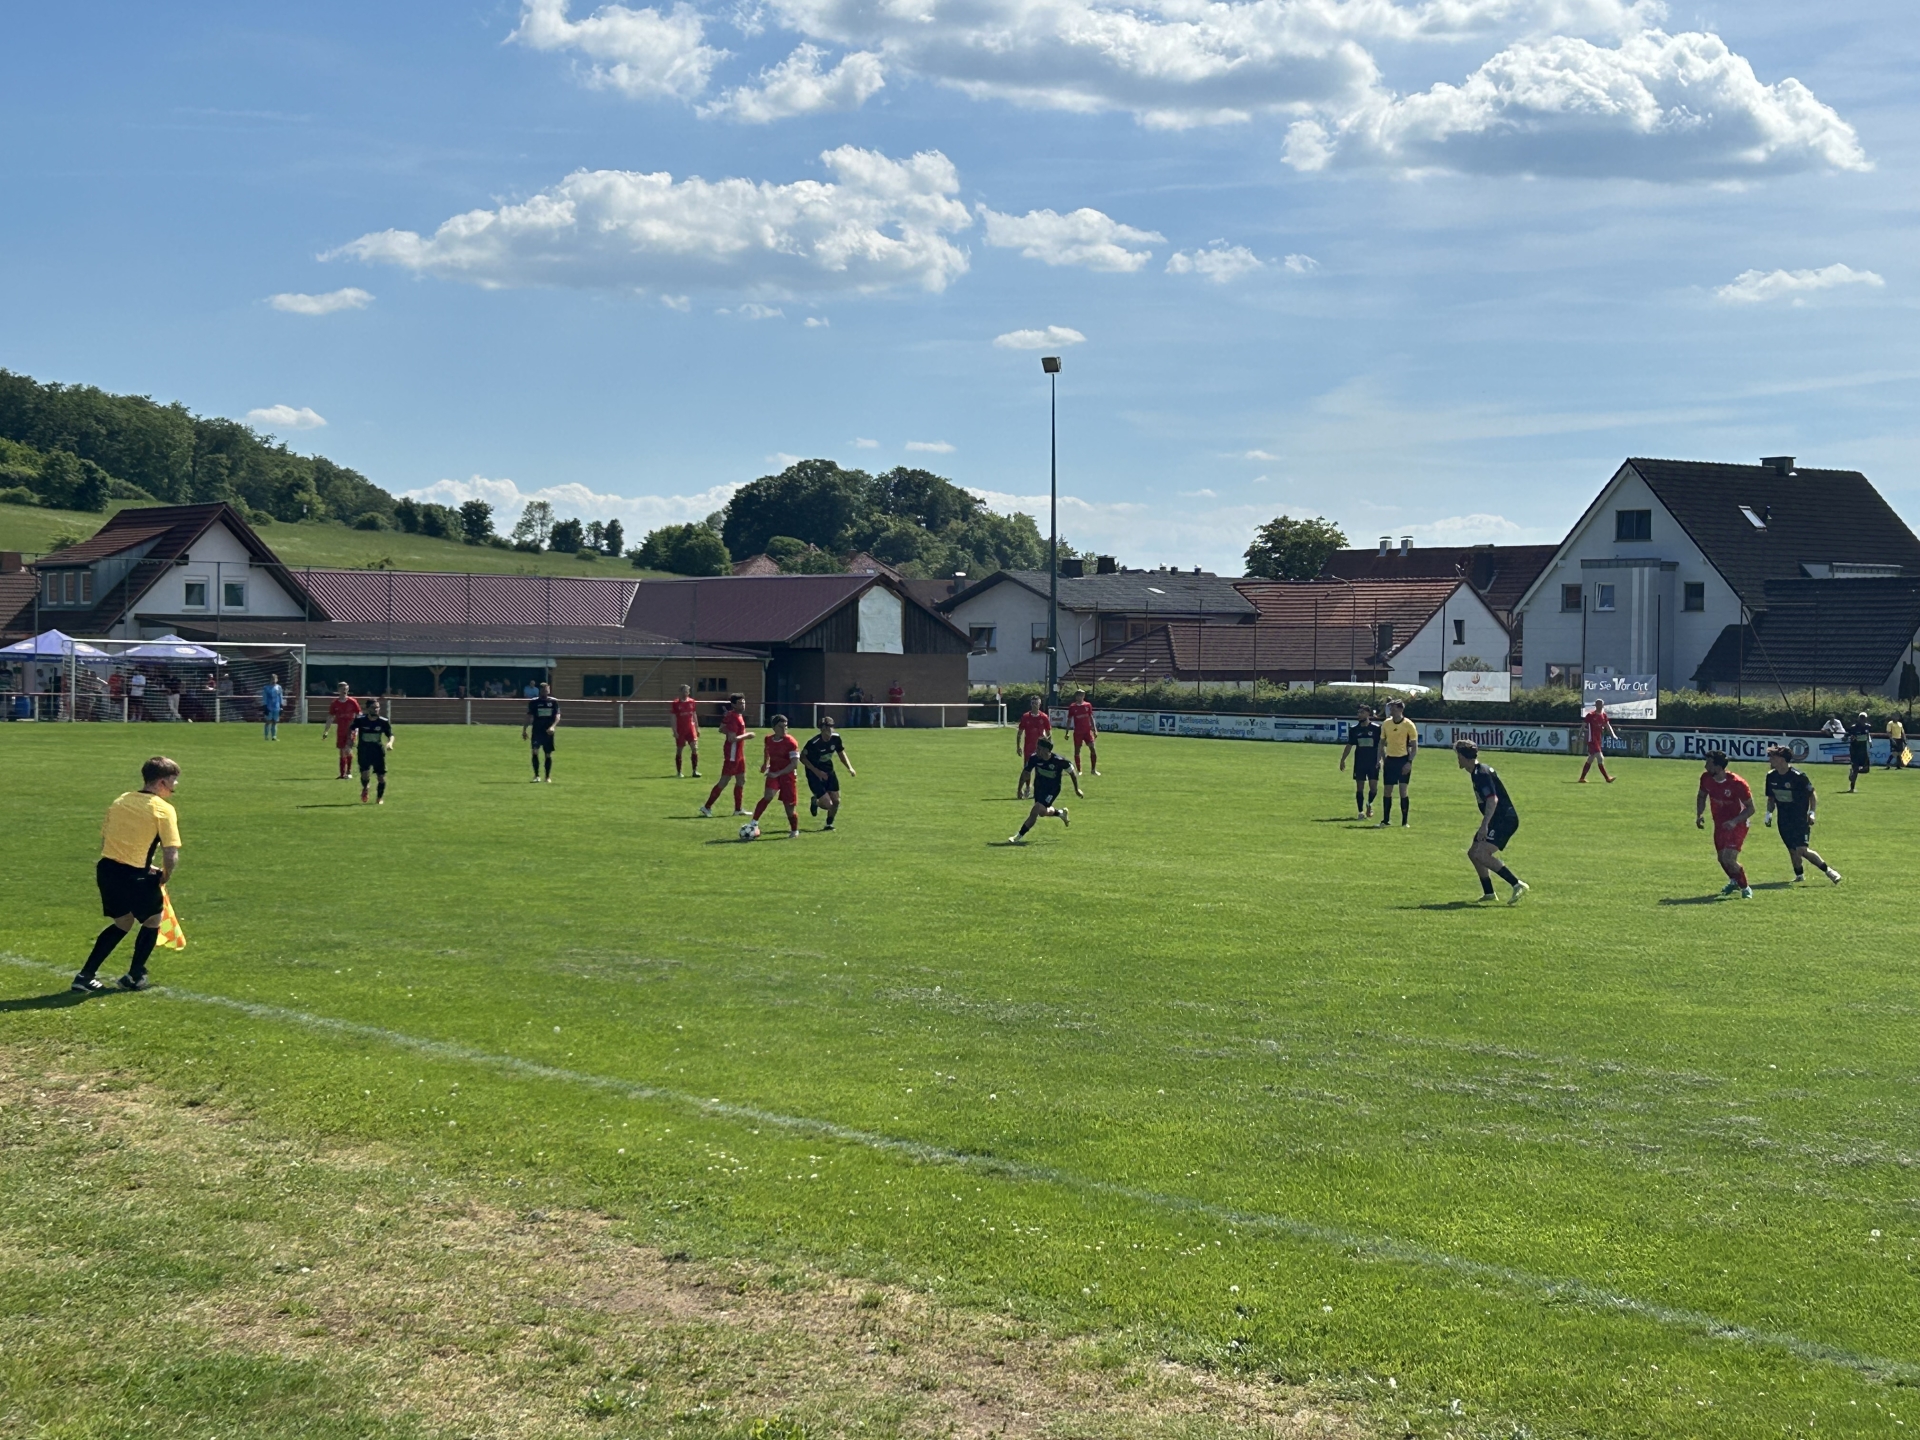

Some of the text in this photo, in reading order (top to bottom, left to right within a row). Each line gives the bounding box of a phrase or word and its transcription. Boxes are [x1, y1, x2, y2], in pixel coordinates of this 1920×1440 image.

[1584, 678, 1649, 691] Für Sie Vor Ort
[1506, 729, 1541, 747] Pils
